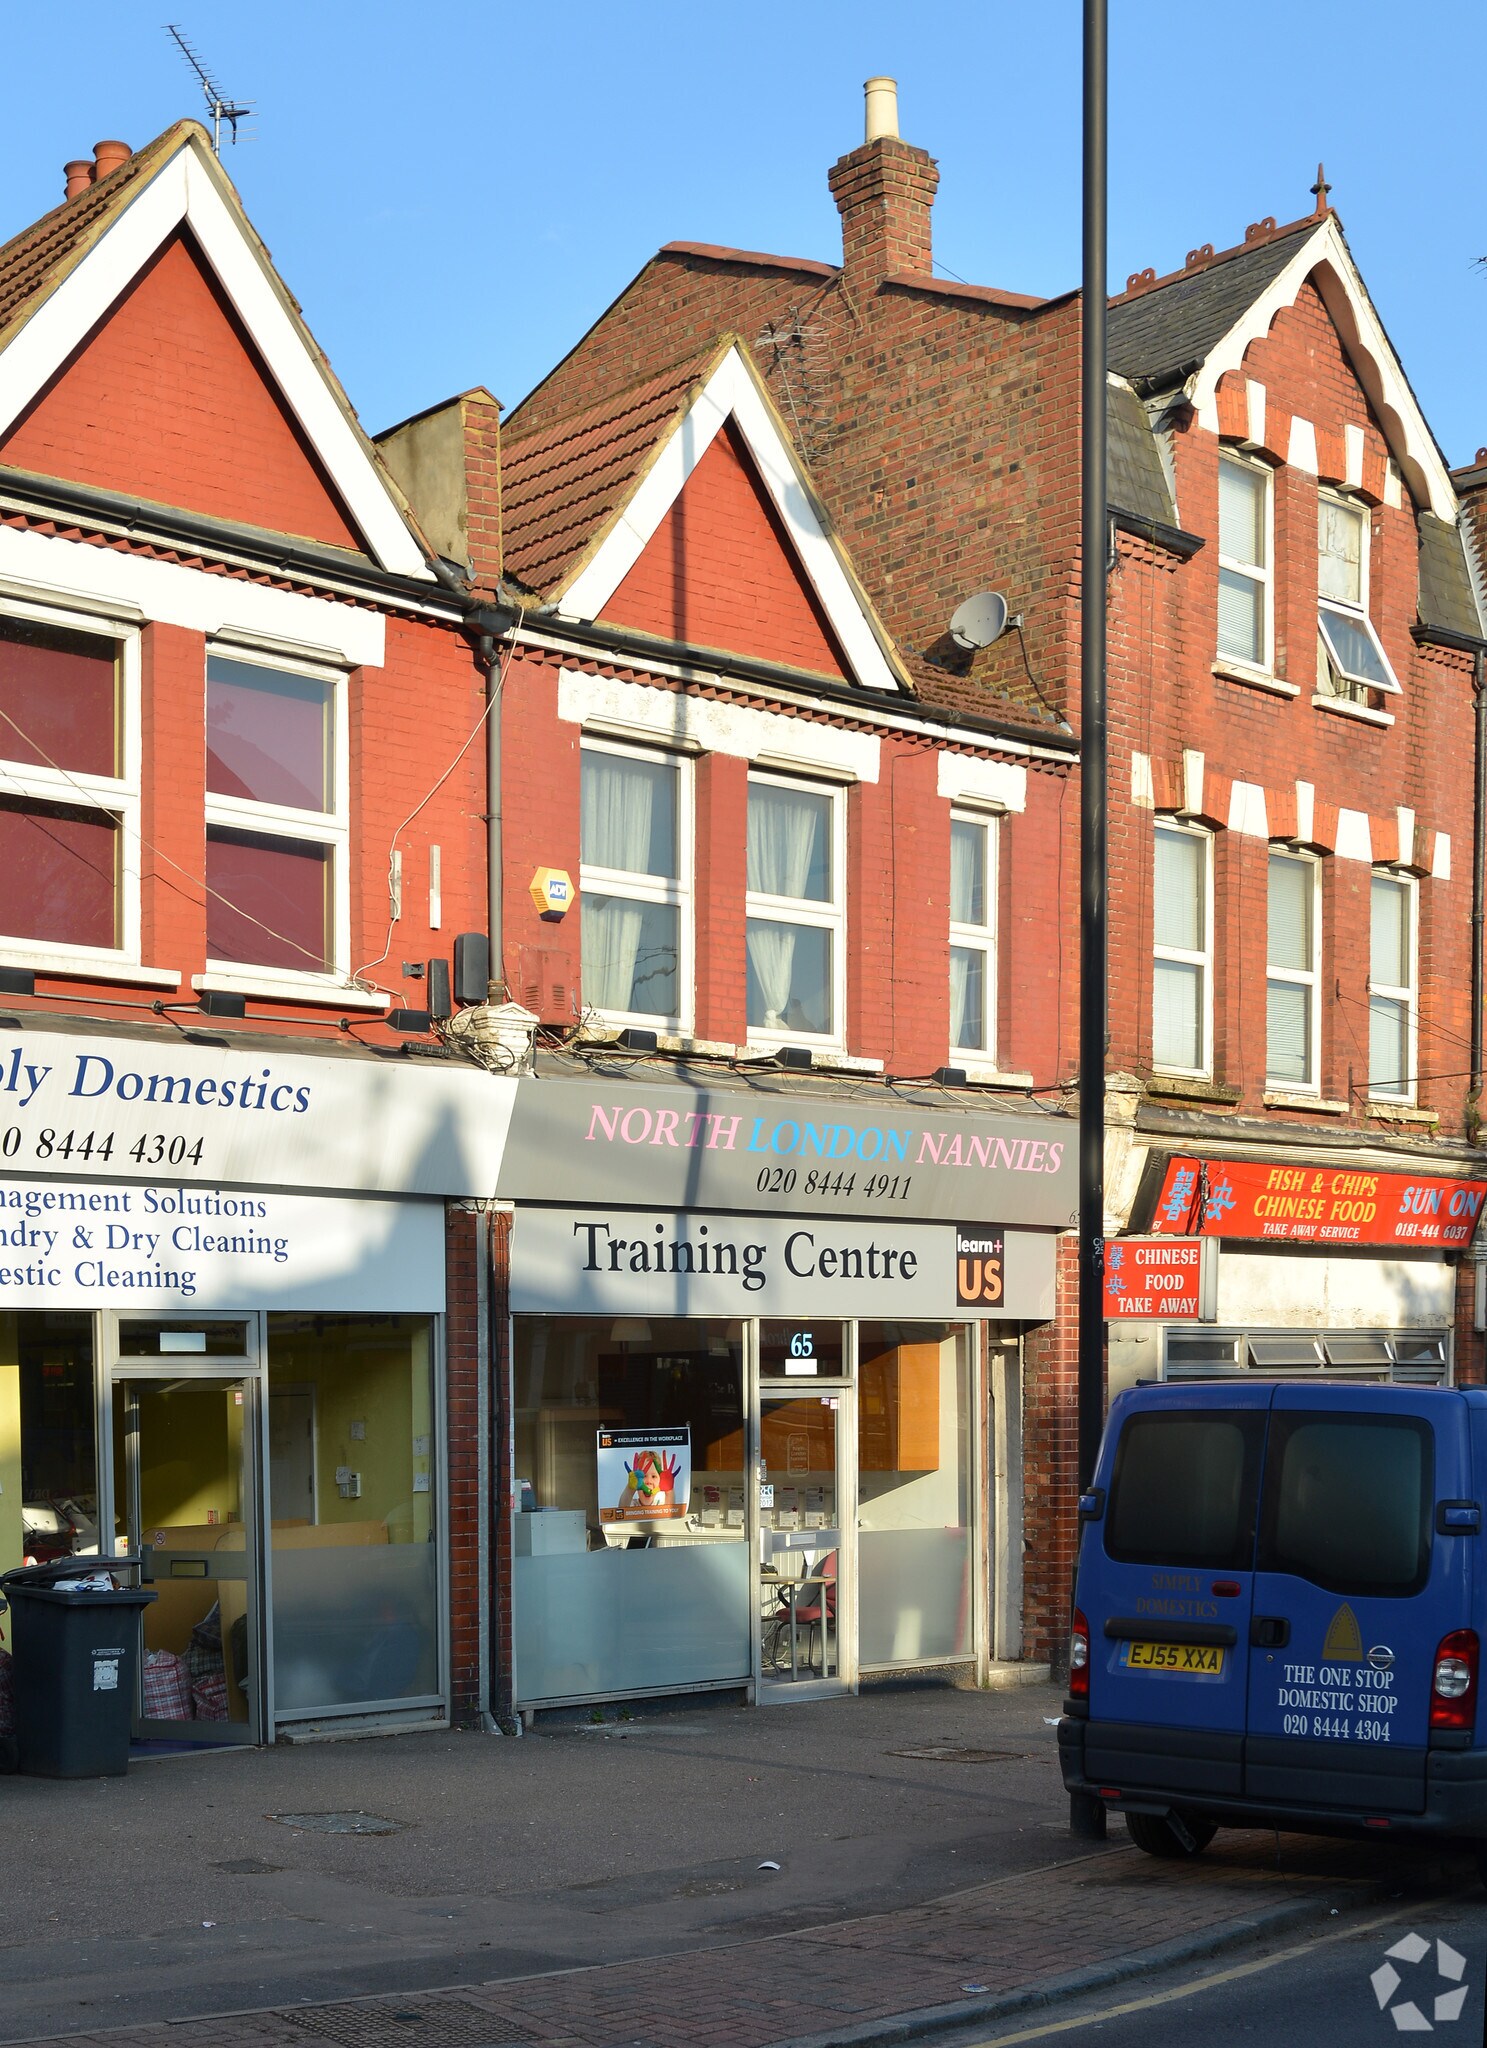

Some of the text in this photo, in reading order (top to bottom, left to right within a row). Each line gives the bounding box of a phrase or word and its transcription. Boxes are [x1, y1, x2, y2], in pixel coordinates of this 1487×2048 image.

[550, 883, 566, 896] ADT
[0, 1048, 312, 1114] ly Domestics
[35, 1128, 115, 1162] 8444
[129, 1133, 204, 1165] 4304
[585, 1104, 1064, 1175] NORTH LONDON NANNIES
[756, 1166, 913, 1201] 020 8444 4911
[1266, 1169, 1379, 1197] FISH & CHIPS
[144, 1187, 267, 1217] Solutions
[1253, 1194, 1376, 1223] CHINESE FOOD
[1399, 1186, 1482, 1217] SUN ON
[1152, 1220, 1162, 1230] 67
[1263, 1222, 1360, 1239] TAKE AWAY SERVICE
[1395, 1222, 1468, 1240] 0181-444 6037
[72, 1225, 94, 1249] &
[106, 1224, 160, 1259] Dry
[172, 1226, 288, 1262] Cleaning
[573, 1220, 918, 1291] Training Centre
[1135, 1248, 1198, 1265] CHINESE
[0, 1259, 196, 1296] estic Cleaning
[958, 1259, 1003, 1301] US
[1145, 1274, 1184, 1291] FOOD
[1118, 1297, 1197, 1313] TAKE AWAY
[790, 1333, 813, 1357] 65
[1152, 1573, 1203, 1592] SIMPLY
[1136, 1597, 1218, 1617] DOMESTICS
[1131, 1645, 1218, 1670] EJ55 XXA
[1284, 1664, 1394, 1690] THE ONE STOP
[1278, 1688, 1398, 1715] DOMESTIC SHOP
[1283, 1714, 1391, 1742] 020 8444 4304
